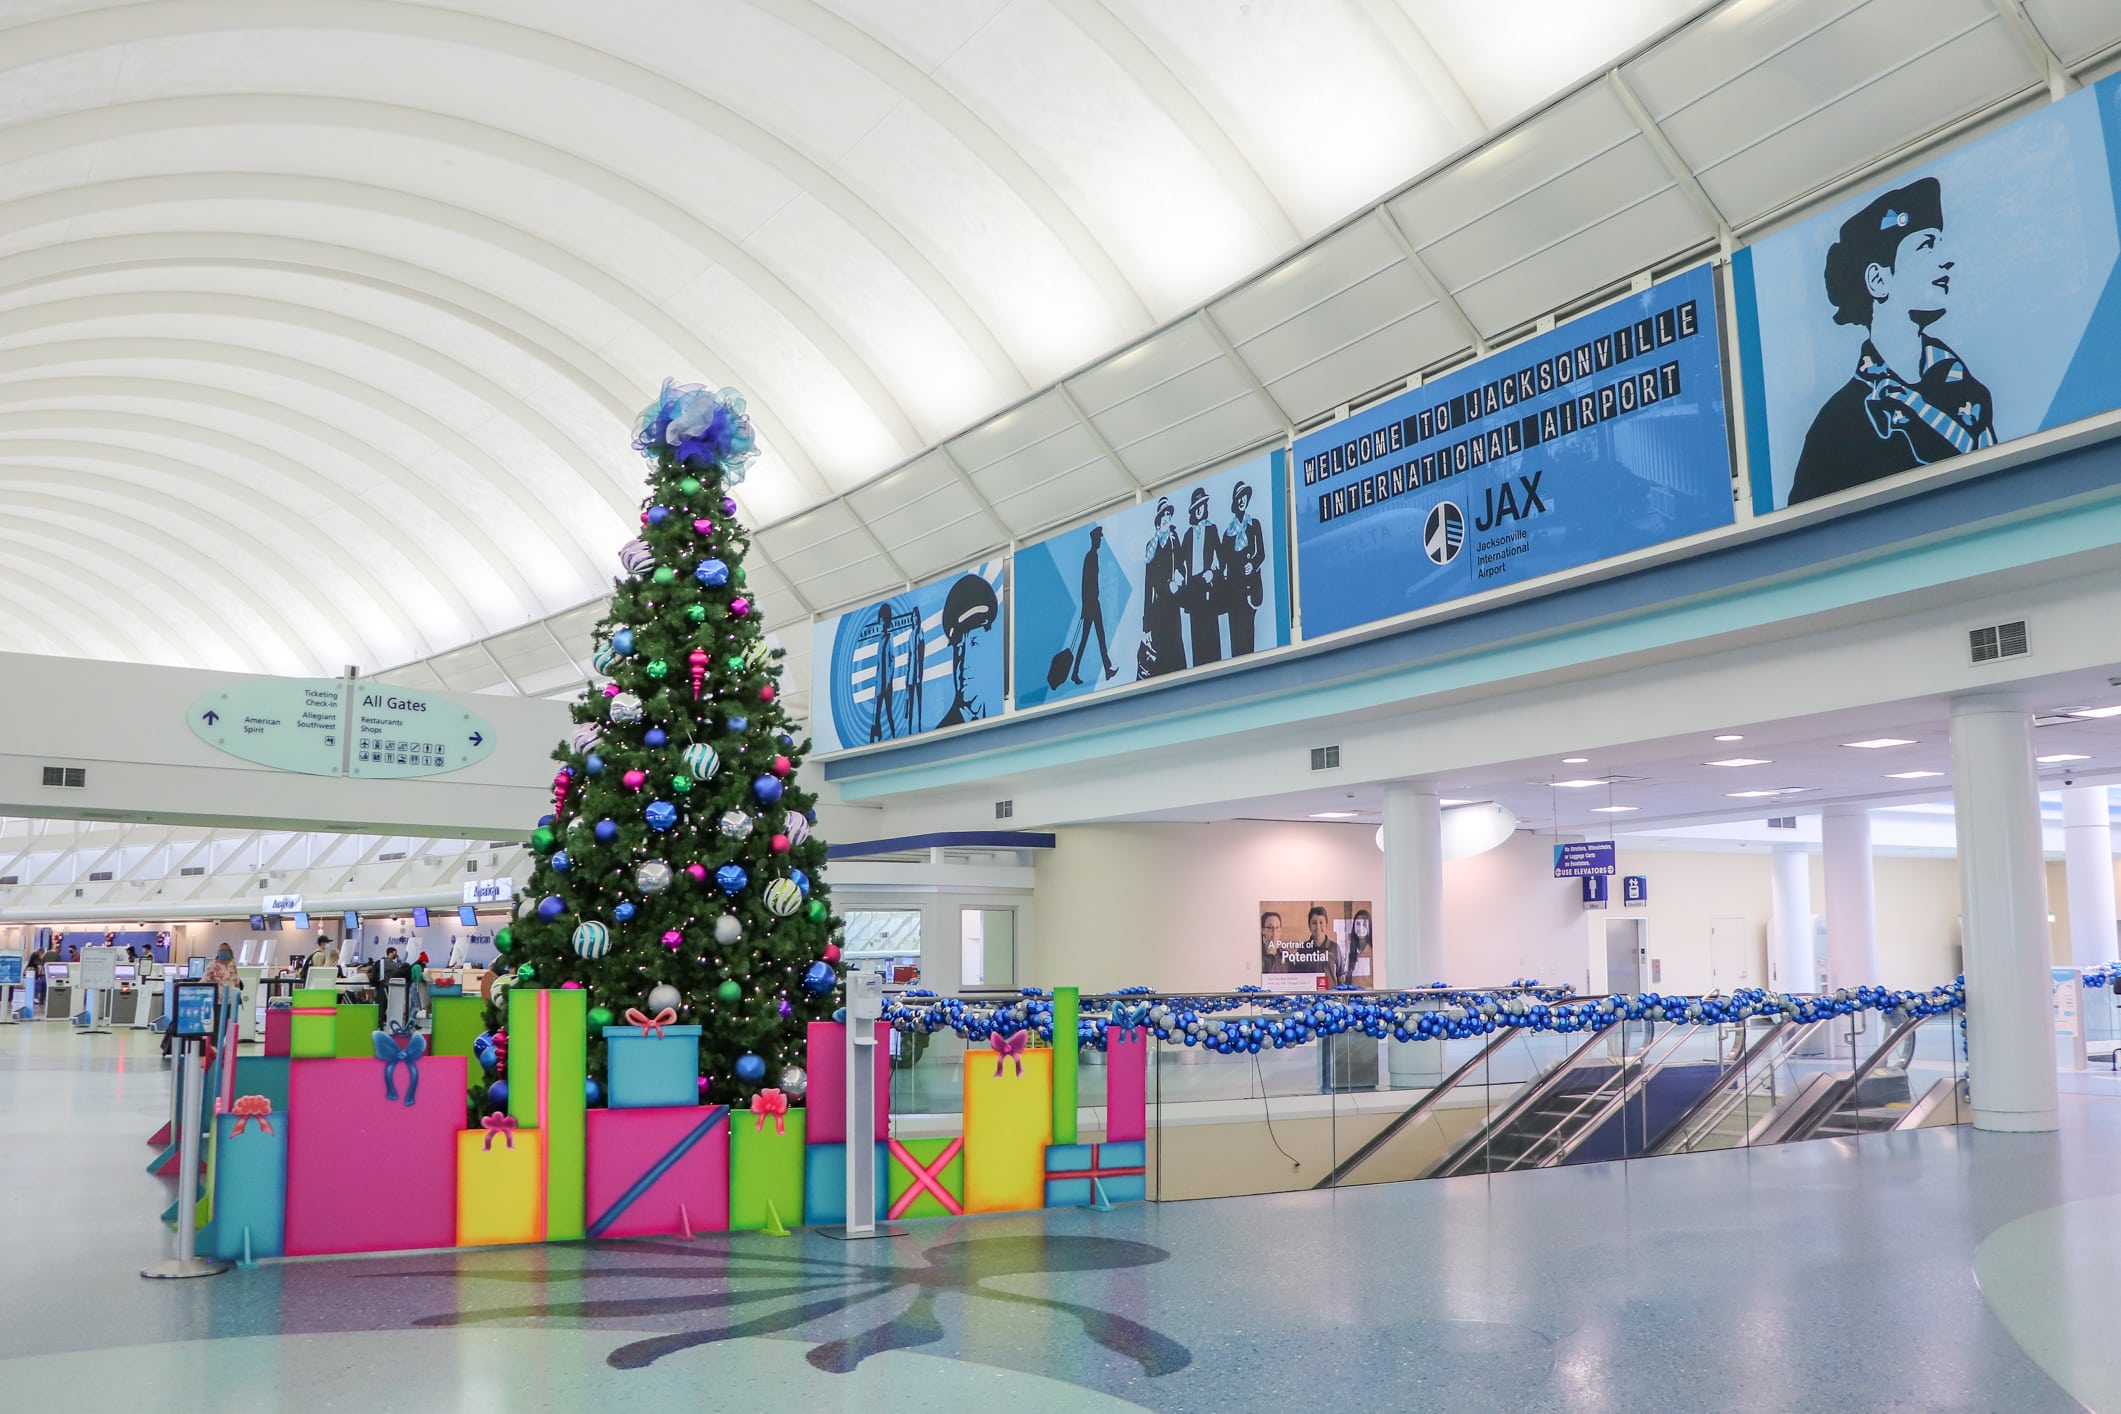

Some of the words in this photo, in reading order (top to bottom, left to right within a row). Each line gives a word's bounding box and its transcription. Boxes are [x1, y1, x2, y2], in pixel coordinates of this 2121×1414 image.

[1305, 425, 1400, 484] WELCOME
[1420, 406, 1448, 437] TO
[1469, 305, 1695, 419] JACKSONVILLE
[1323, 426, 1519, 519] INTERNATIONAL
[1544, 365, 1677, 440] AIRPORT
[1474, 470, 1546, 532] JAX
[1476, 529, 1528, 552] Jacksonville
[1477, 541, 1530, 566] International
[1478, 562, 1506, 579] Airport
[305, 689, 338, 700] Ticketing
[306, 699, 338, 708] Check-In
[362, 695, 382, 708] All
[387, 697, 427, 712] Gates
[244, 716, 281, 726] American
[302, 711, 336, 721] Allegiant
[361, 716, 403, 727] Restaurants
[243, 725, 264, 734] Spirit
[297, 720, 336, 730] Southwest
[360, 725, 382, 734] Shops
[1574, 867, 1607, 875] ELEVATORS
[1268, 941, 1275, 949] A
[1276, 940, 1304, 949] Portrait
[1305, 940, 1314, 949] of
[1281, 950, 1329, 963] Potential
